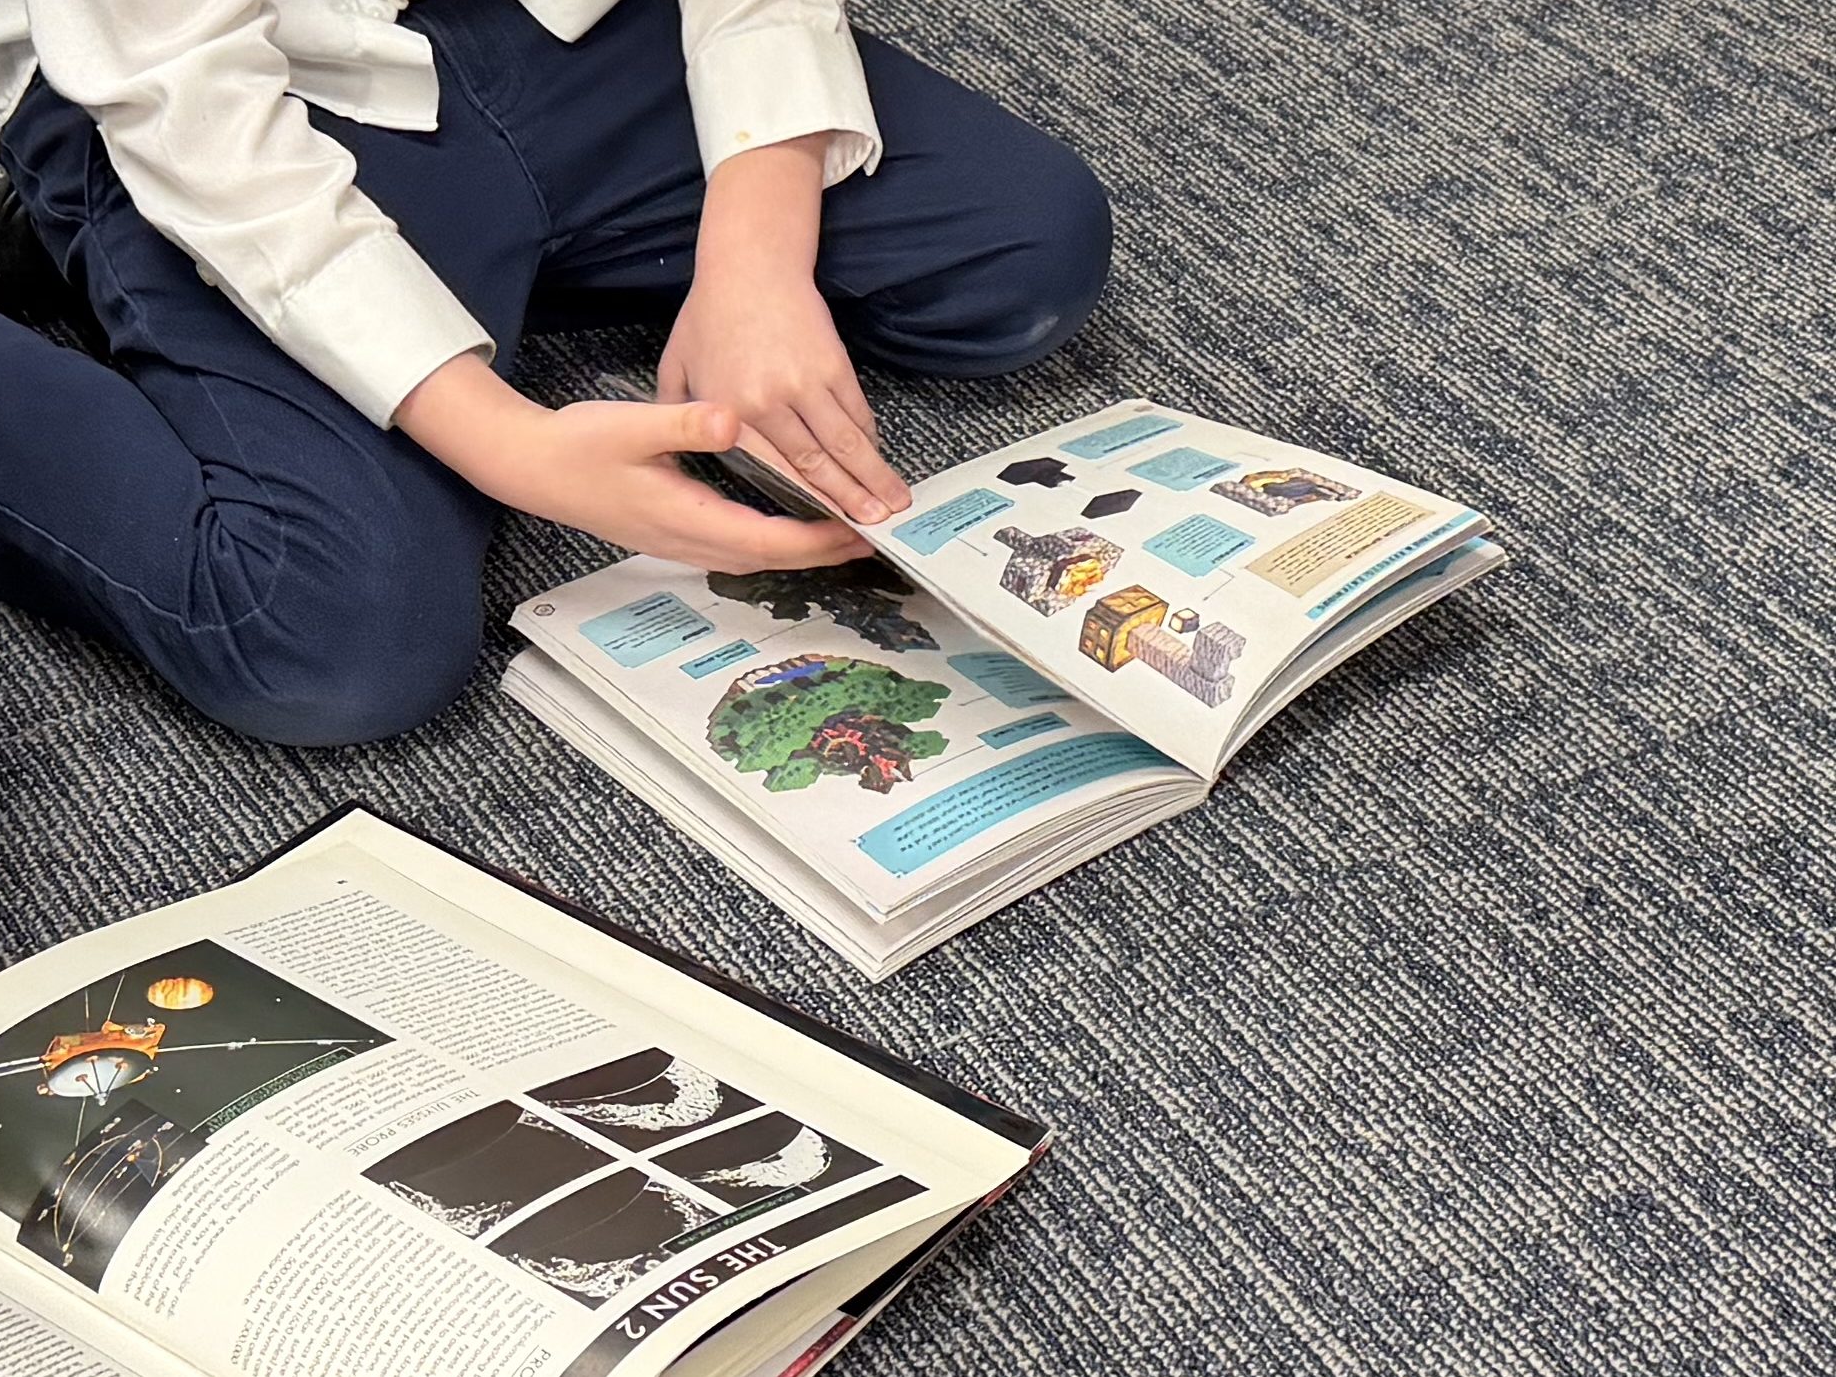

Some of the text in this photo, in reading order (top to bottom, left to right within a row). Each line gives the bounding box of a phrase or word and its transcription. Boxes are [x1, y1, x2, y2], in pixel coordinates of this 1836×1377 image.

[344, 1088, 479, 1158] THE ULYSSES PROBE
[613, 1234, 787, 1341] THE SUN 2
